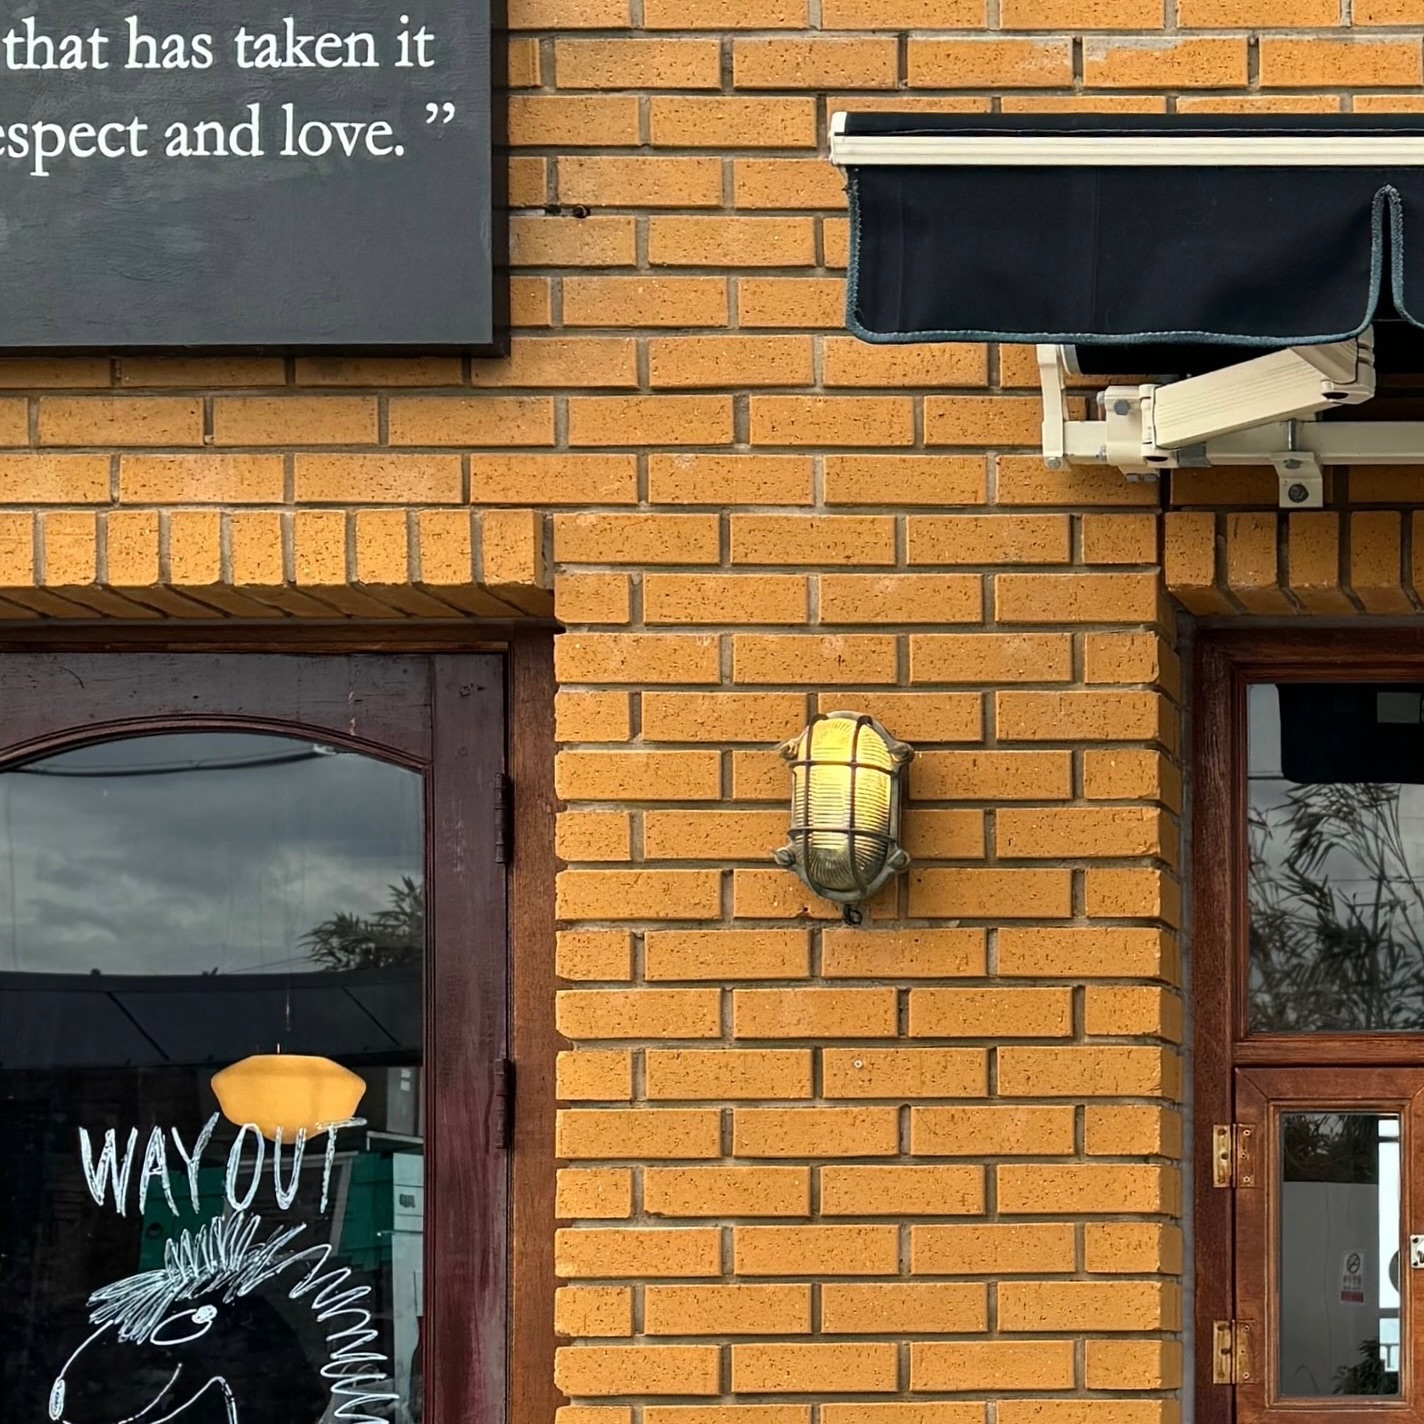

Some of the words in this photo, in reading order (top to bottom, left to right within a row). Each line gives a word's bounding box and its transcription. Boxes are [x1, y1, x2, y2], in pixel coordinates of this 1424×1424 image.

[2, 16, 109, 70] that
[124, 15, 213, 69] has
[234, 16, 380, 68] taken
[394, 14, 435, 68] it
[0, 115, 148, 177] spect
[164, 102, 265, 158] and
[280, 102, 405, 157] love.
[79, 1111, 220, 1217] WAY
[225, 1117, 368, 1214] OUT
